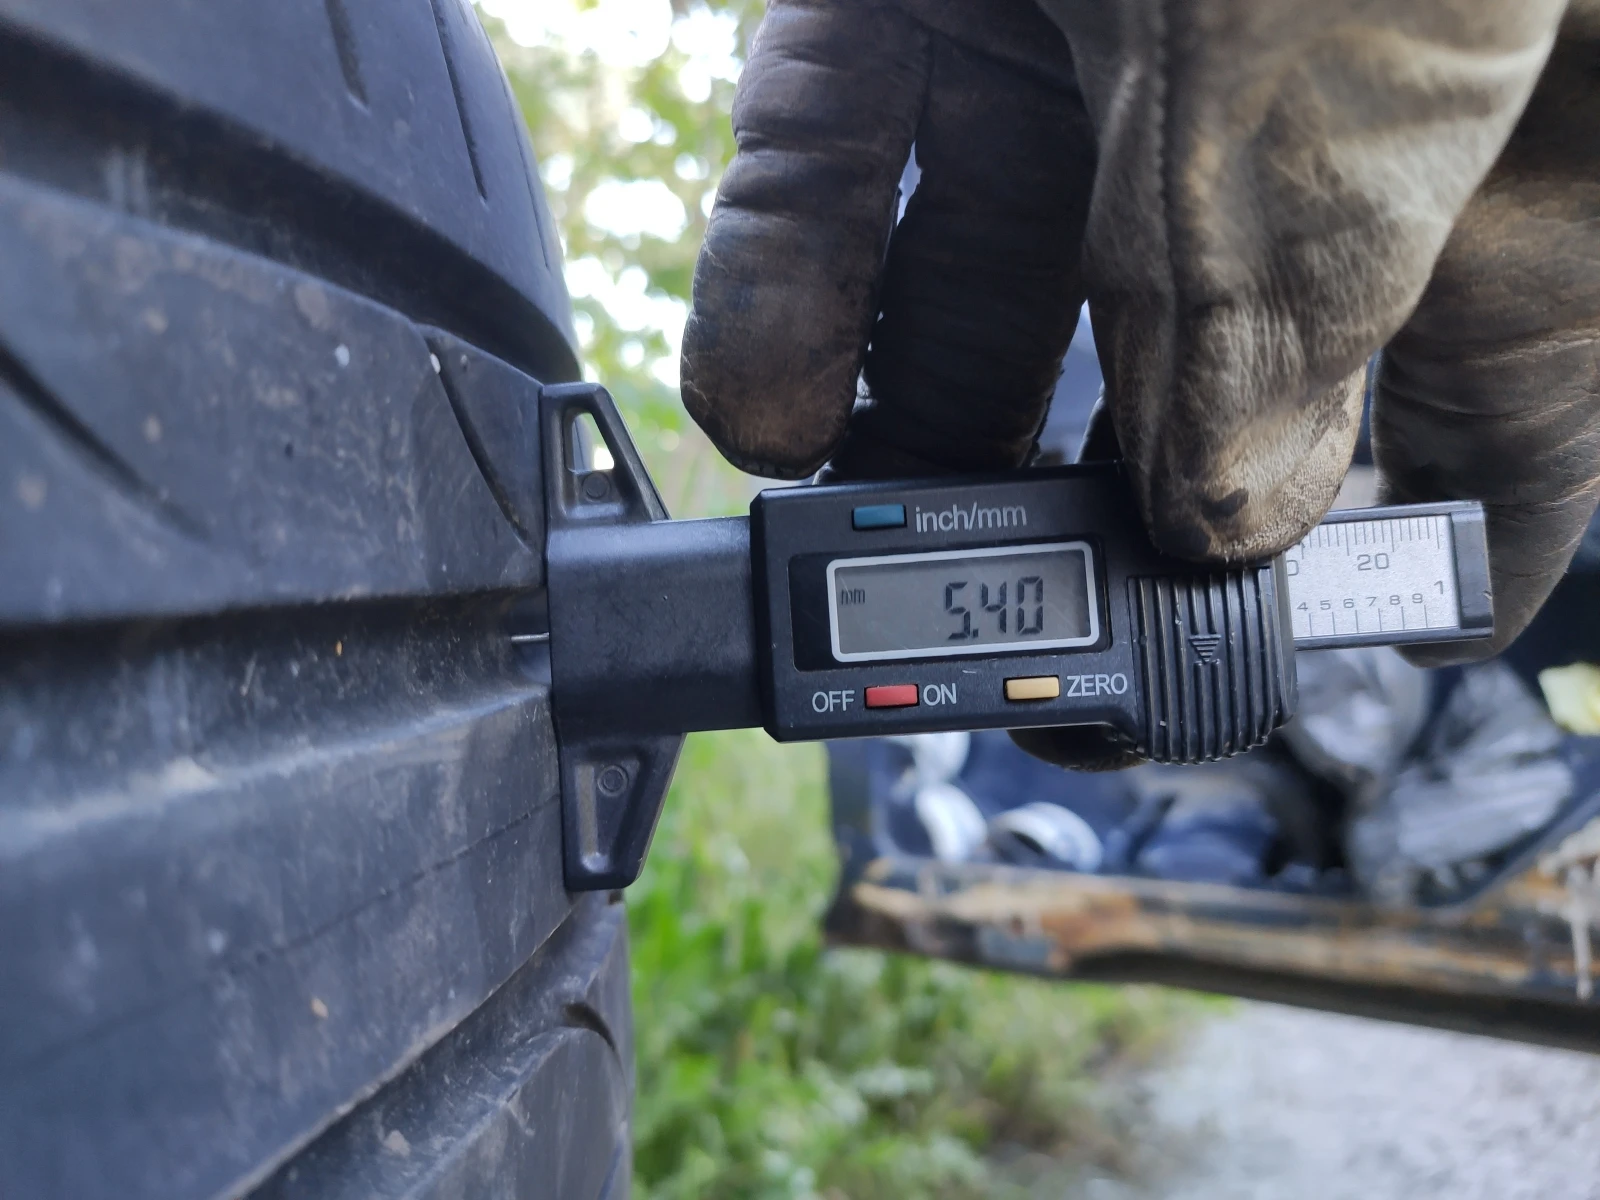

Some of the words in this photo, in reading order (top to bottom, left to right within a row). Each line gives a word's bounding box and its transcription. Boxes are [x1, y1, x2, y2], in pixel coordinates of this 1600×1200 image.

[915, 502, 1027, 533] inch/mm
[1286, 559, 1300, 577] 0
[1357, 552, 1390, 571] 20
[944, 575, 1044, 641] 5.40
[1296, 601, 1309, 612] 4
[1320, 600, 1331, 611] 5
[1343, 598, 1355, 609] 6
[1366, 596, 1377, 607] 7
[1389, 595, 1401, 606] 8
[1411, 593, 1424, 604] 9
[1434, 580, 1444, 595] 1
[811, 690, 855, 713] OFF
[923, 682, 957, 706] ON
[1066, 672, 1128, 698] ZERO
